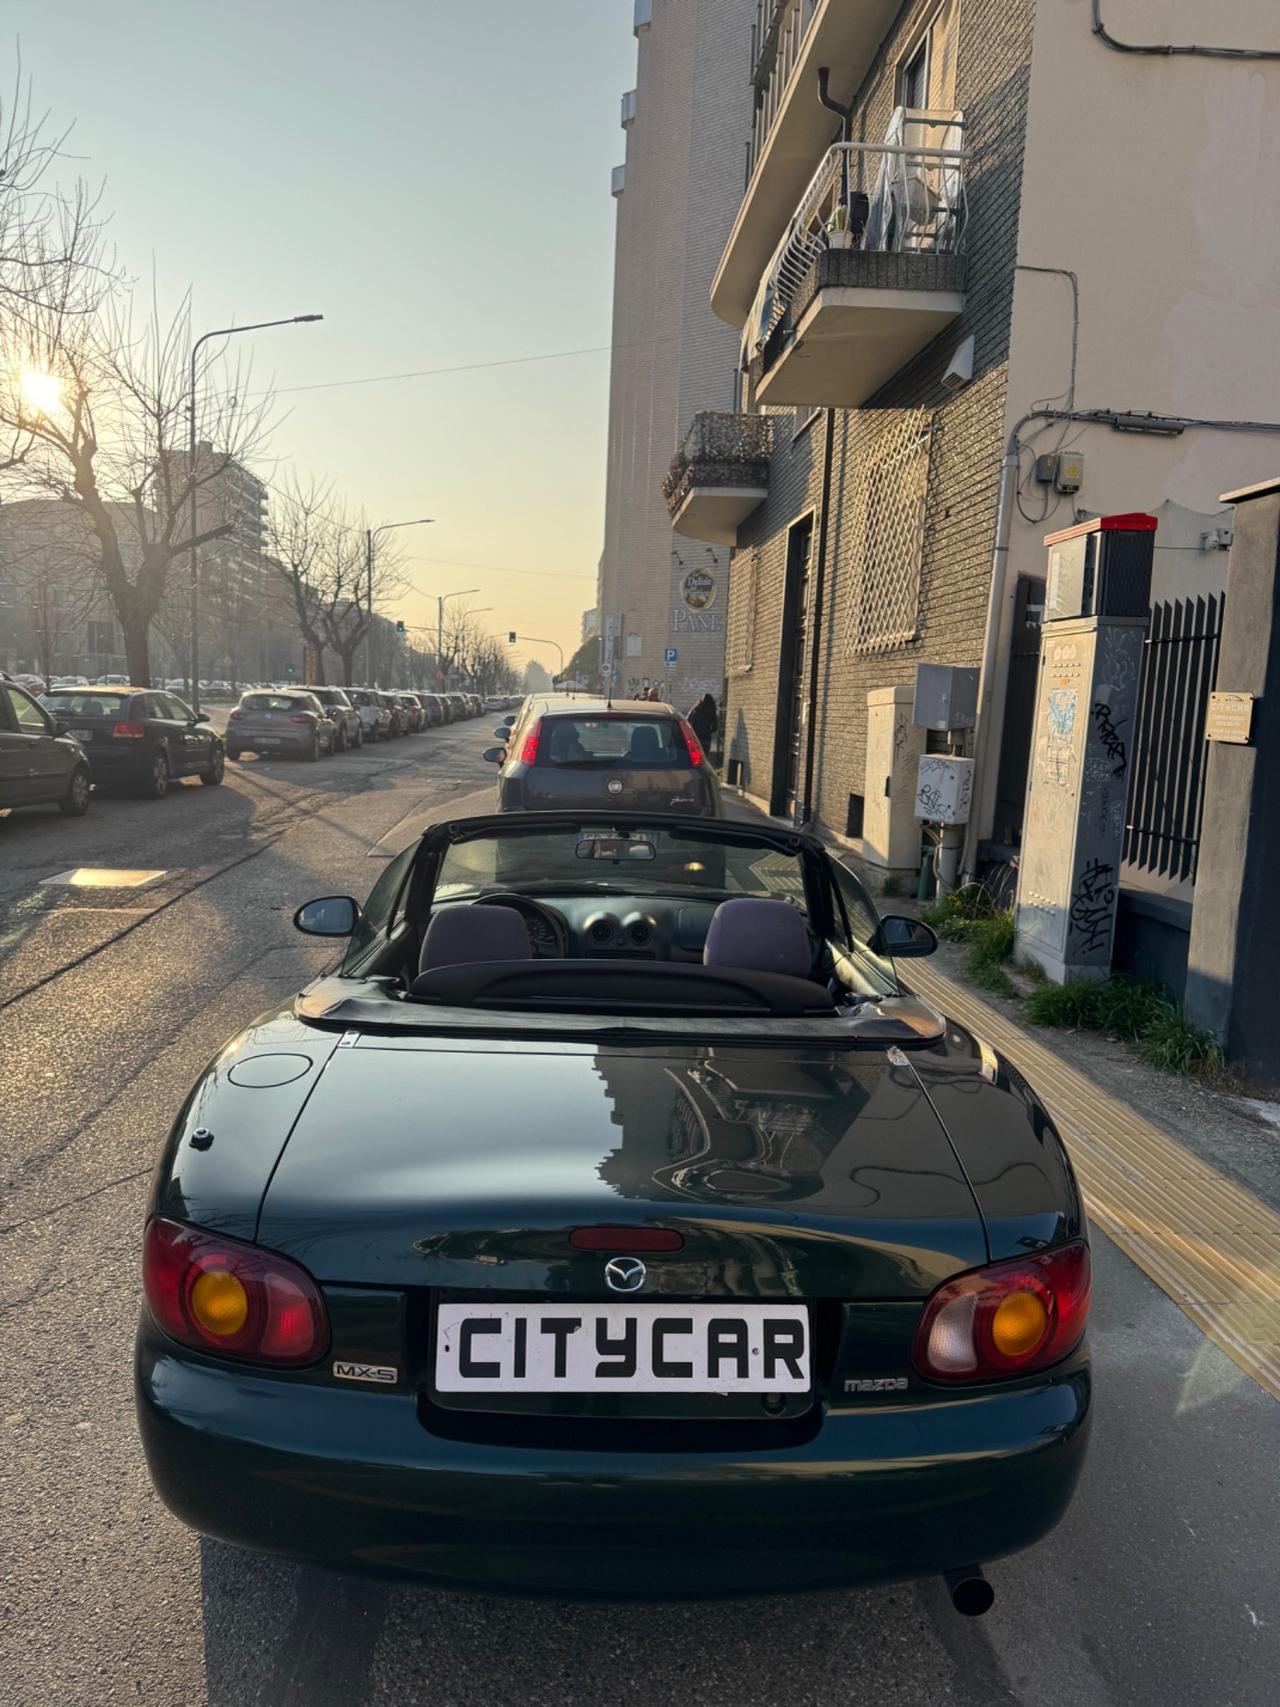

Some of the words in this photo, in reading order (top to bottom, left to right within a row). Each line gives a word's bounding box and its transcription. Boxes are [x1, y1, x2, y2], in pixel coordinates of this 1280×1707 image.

[666, 649, 676, 660] P
[458, 1317, 805, 1379] CITYCAR
[336, 1363, 396, 1381] MX-5
